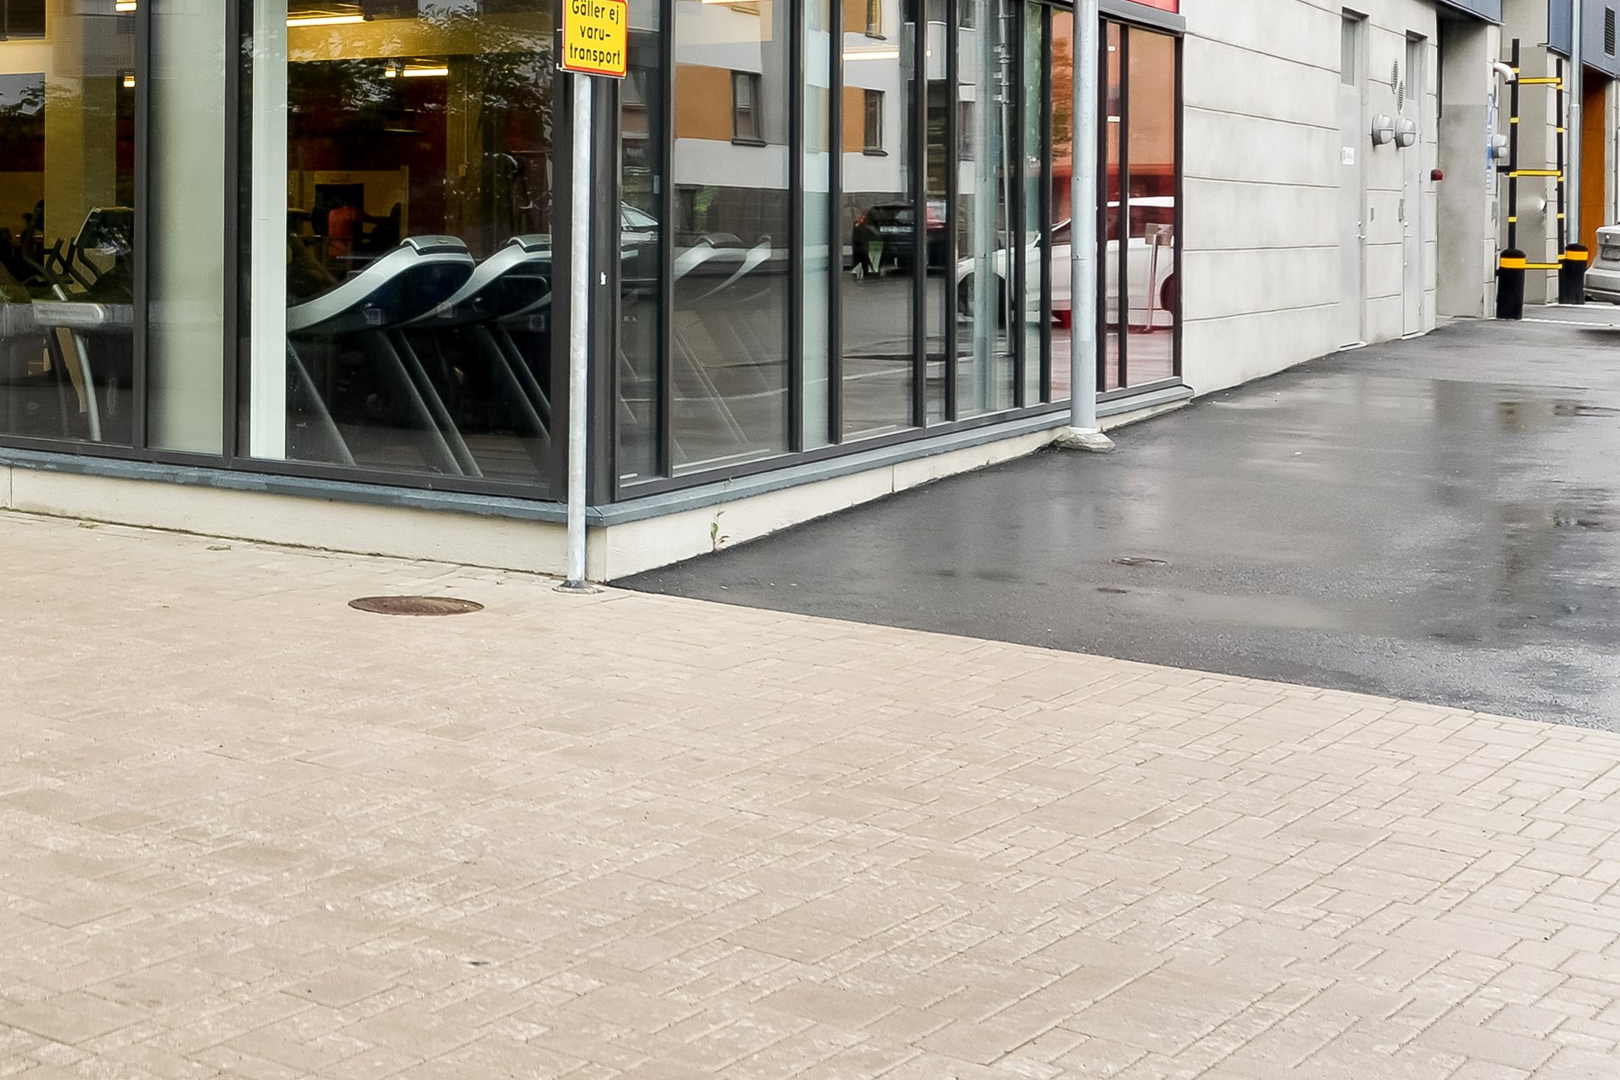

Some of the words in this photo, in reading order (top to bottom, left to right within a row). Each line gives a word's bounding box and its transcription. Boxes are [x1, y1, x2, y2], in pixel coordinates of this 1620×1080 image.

[609, 5, 619, 25] ej
[580, 25, 611, 41] varu-
[570, 43, 620, 66] transport
